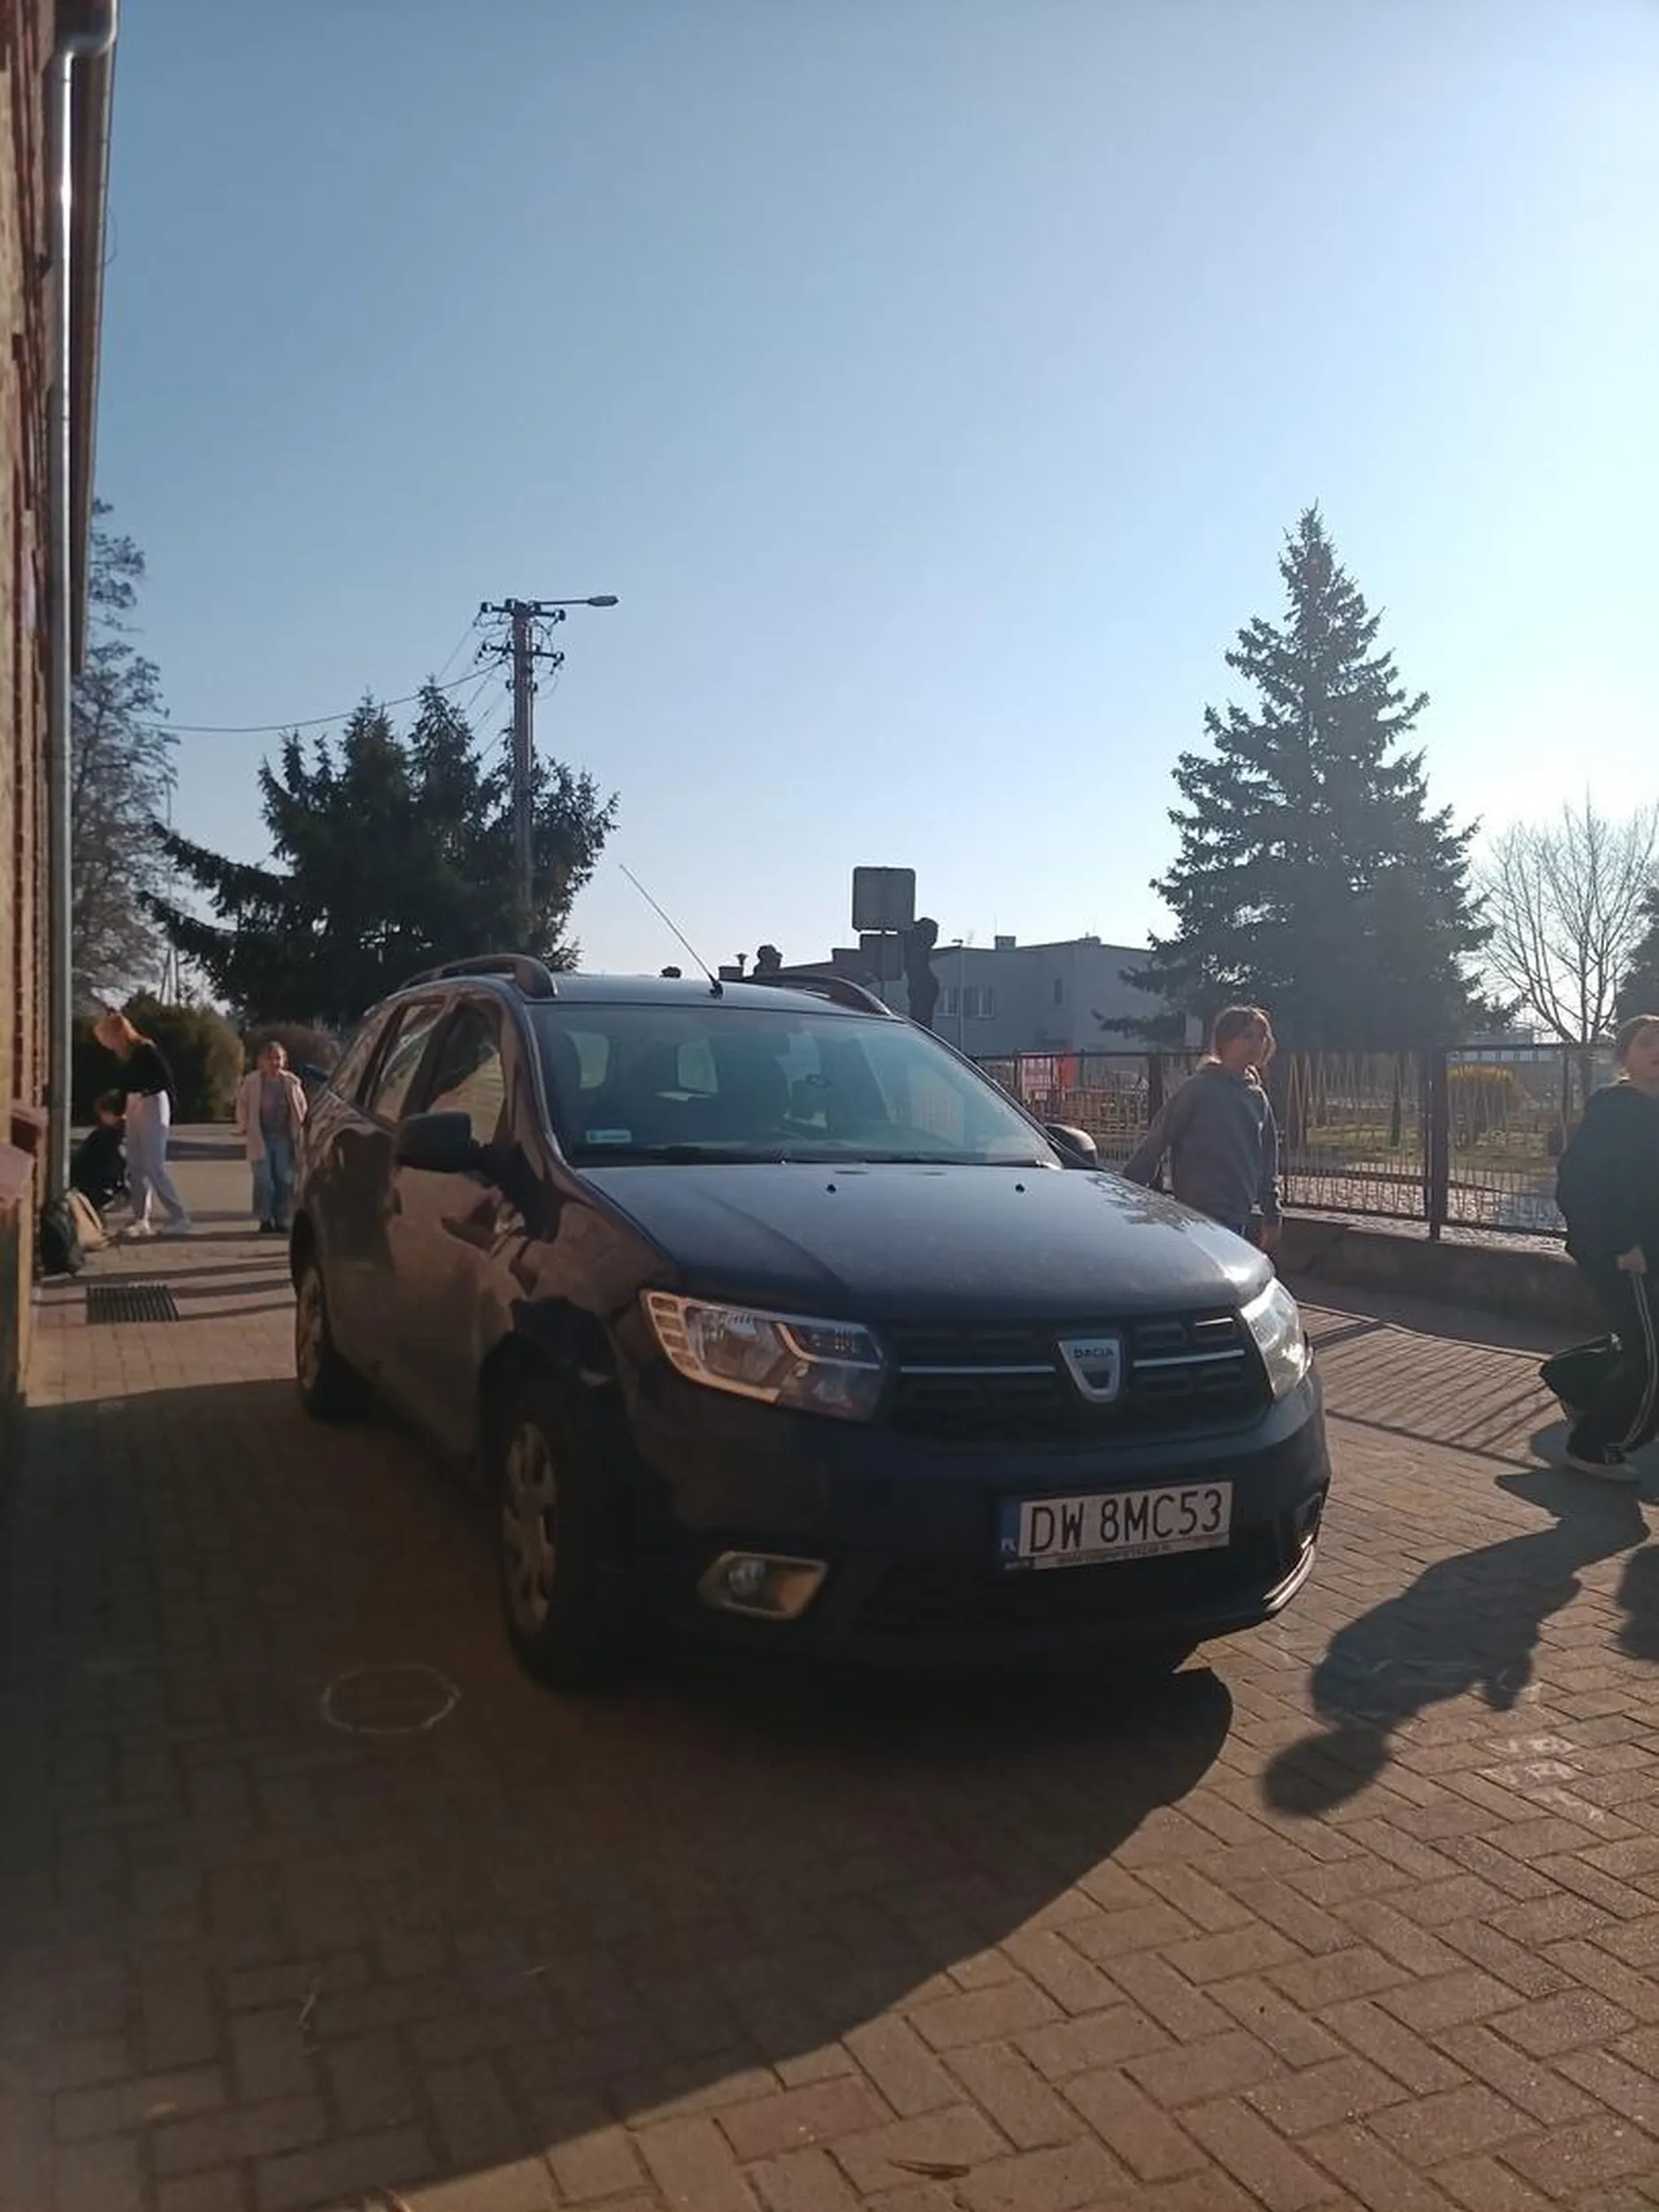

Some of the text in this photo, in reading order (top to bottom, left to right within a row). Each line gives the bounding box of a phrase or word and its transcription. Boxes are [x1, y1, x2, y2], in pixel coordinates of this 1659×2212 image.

[1073, 1348, 1114, 1358] DACIA
[1030, 1490, 1222, 1553] DW 8MC53
